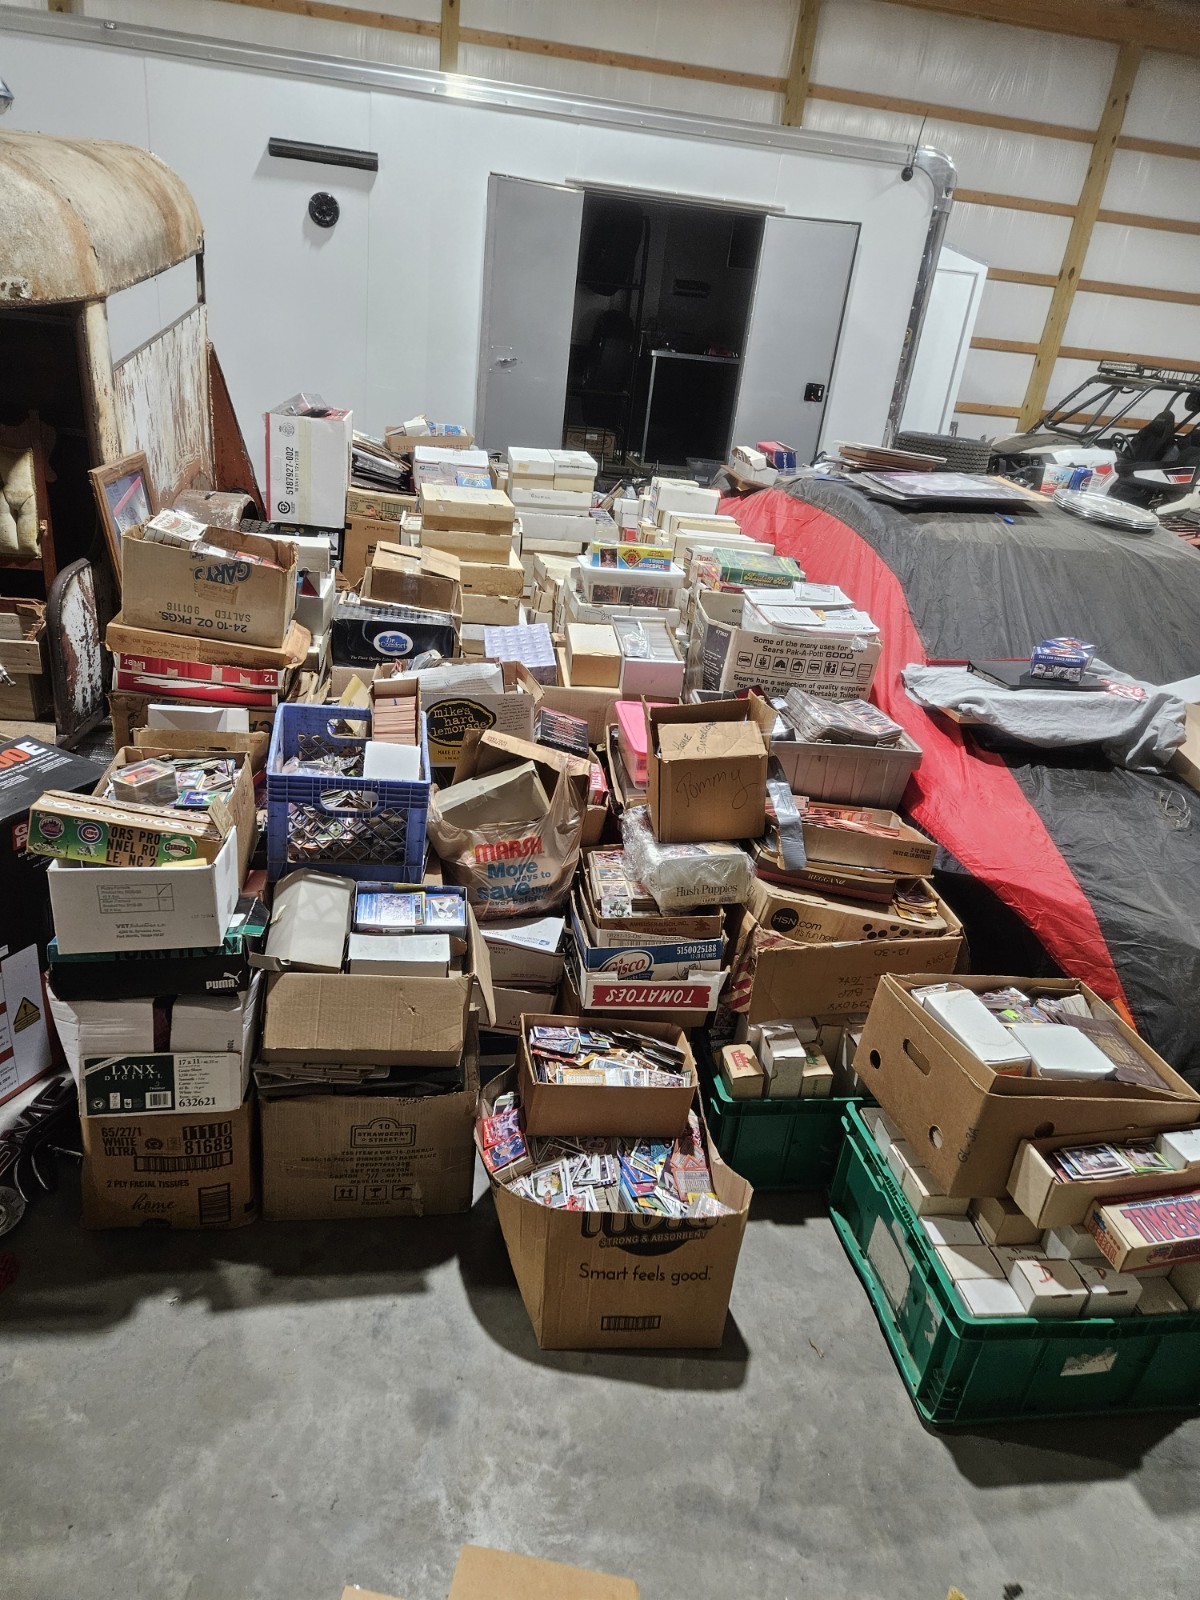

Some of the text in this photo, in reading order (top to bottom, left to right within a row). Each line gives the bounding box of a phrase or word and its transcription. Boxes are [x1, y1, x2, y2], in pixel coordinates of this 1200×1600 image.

[285, 446, 294, 496] 5187927-002
[159, 611, 192, 625] PKGS.
[215, 609, 251, 623] SALTED
[217, 621, 248, 633] 24-10
[380, 641, 408, 649] Comfort
[753, 636, 774, 645] Some
[785, 640, 798, 648] the
[799, 643, 819, 651] many
[762, 645, 785, 654] Sears
[826, 651, 854, 660] 6000
[264, 674, 275, 683] 12
[733, 674, 754, 683] Sears
[756, 676, 769, 685] has
[777, 678, 807, 689] selection
[816, 682, 839, 692] quality
[840, 684, 866, 693] supplies
[839, 691, 860, 699] Toilets
[433, 706, 472, 719] mike's
[444, 714, 476, 728] hard
[431, 720, 487, 738] lemonade
[675, 769, 759, 810] Tommy
[109, 825, 134, 840] ORS
[128, 854, 143, 866] NC
[487, 861, 538, 879] More
[513, 871, 551, 883] ways to
[477, 882, 553, 901] save than
[676, 883, 738, 897] Hush Puppies
[489, 898, 510, 906] ever
[805, 929, 817, 938] fun
[676, 944, 717, 955] 5150025188
[205, 979, 237, 990] PUMA
[605, 988, 695, 1004] TOMATOES
[104, 1073, 163, 1081] DIGITAL
[111, 1064, 157, 1076] LYNX
[178, 1097, 216, 1107] 632621
[101, 1127, 142, 1138] 65/27/1
[184, 1122, 231, 1140] 11110
[102, 1137, 137, 1147] WHITE
[184, 1137, 233, 1155] 81689
[105, 1147, 138, 1157] ULTRA
[130, 1180, 157, 1188] FACIAL
[159, 1179, 190, 1188] TISSUES
[132, 1193, 176, 1210] home
[599, 1233, 639, 1248] STRONG
[651, 1230, 707, 1243] ABSORBENT
[579, 1262, 711, 1286] Smart feels good.
